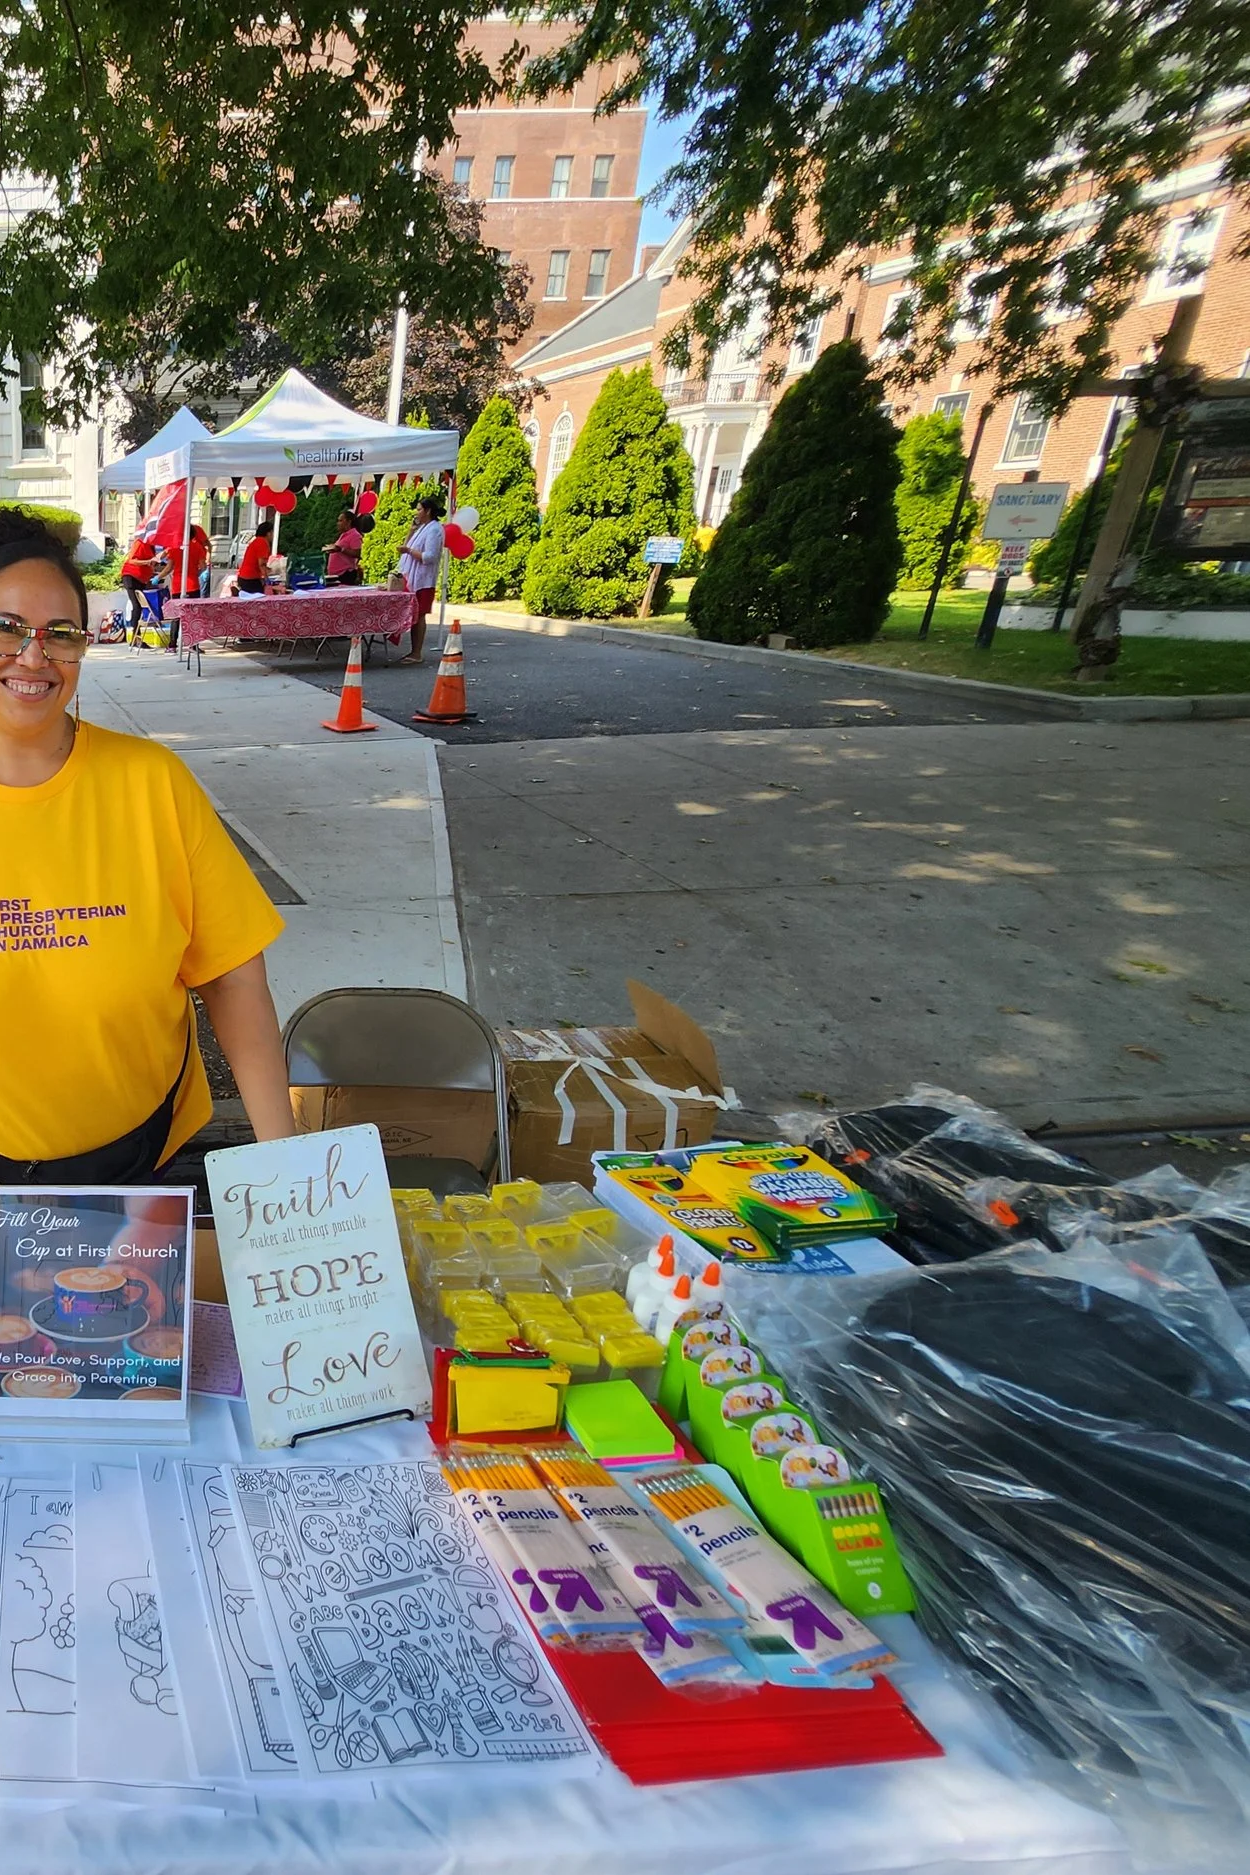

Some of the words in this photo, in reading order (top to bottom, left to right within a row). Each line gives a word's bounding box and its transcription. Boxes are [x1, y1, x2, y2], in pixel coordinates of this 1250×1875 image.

[297, 448, 364, 464] healthfirst
[995, 494, 1062, 506] SANCTUARY
[0, 905, 126, 924] PRESBYTERIAN
[11, 935, 89, 951] JAMAICA
[718, 1150, 799, 1164] Crayola
[628, 1172, 674, 1183] Crayola
[749, 1176, 847, 1195] WASHABLE
[223, 1143, 369, 1239] Faith
[772, 1188, 849, 1204] MARKERS
[668, 1207, 735, 1220] COLORED
[827, 1206, 838, 1218] 8
[31, 1207, 81, 1235] Your
[686, 1216, 746, 1230] PENCILS
[250, 1233, 279, 1249] makes
[282, 1227, 296, 1244] all
[299, 1221, 329, 1242] things
[332, 1215, 367, 1237] possible
[15, 1237, 51, 1261] Cup
[55, 1246, 73, 1257] at
[78, 1244, 112, 1257] First
[117, 1244, 179, 1258] Church
[731, 1238, 752, 1250] 12
[247, 1252, 384, 1308] HOPE
[265, 1310, 294, 1325] makes
[298, 1301, 312, 1318] all
[315, 1298, 345, 1316] things
[349, 1290, 378, 1310] bright
[15, 1353, 47, 1365] Pour
[50, 1354, 85, 1367] Love,
[89, 1354, 150, 1370] Support,
[153, 1355, 180, 1367] and
[262, 1332, 402, 1405] Love
[12, 1370, 56, 1383] Grace
[60, 1372, 87, 1384] into
[90, 1373, 157, 1387] Parenting
[287, 1403, 316, 1421] makes
[320, 1397, 334, 1414] all
[337, 1391, 367, 1412] things
[370, 1384, 395, 1401] work
[462, 1494, 479, 1506] #2
[487, 1495, 507, 1507] #2
[568, 1492, 588, 1504] #2
[499, 1506, 559, 1523] pencils
[581, 1504, 639, 1520] pencils
[683, 1524, 704, 1537] #2
[699, 1525, 759, 1556] pencils
[310, 1605, 344, 1625] ABC
